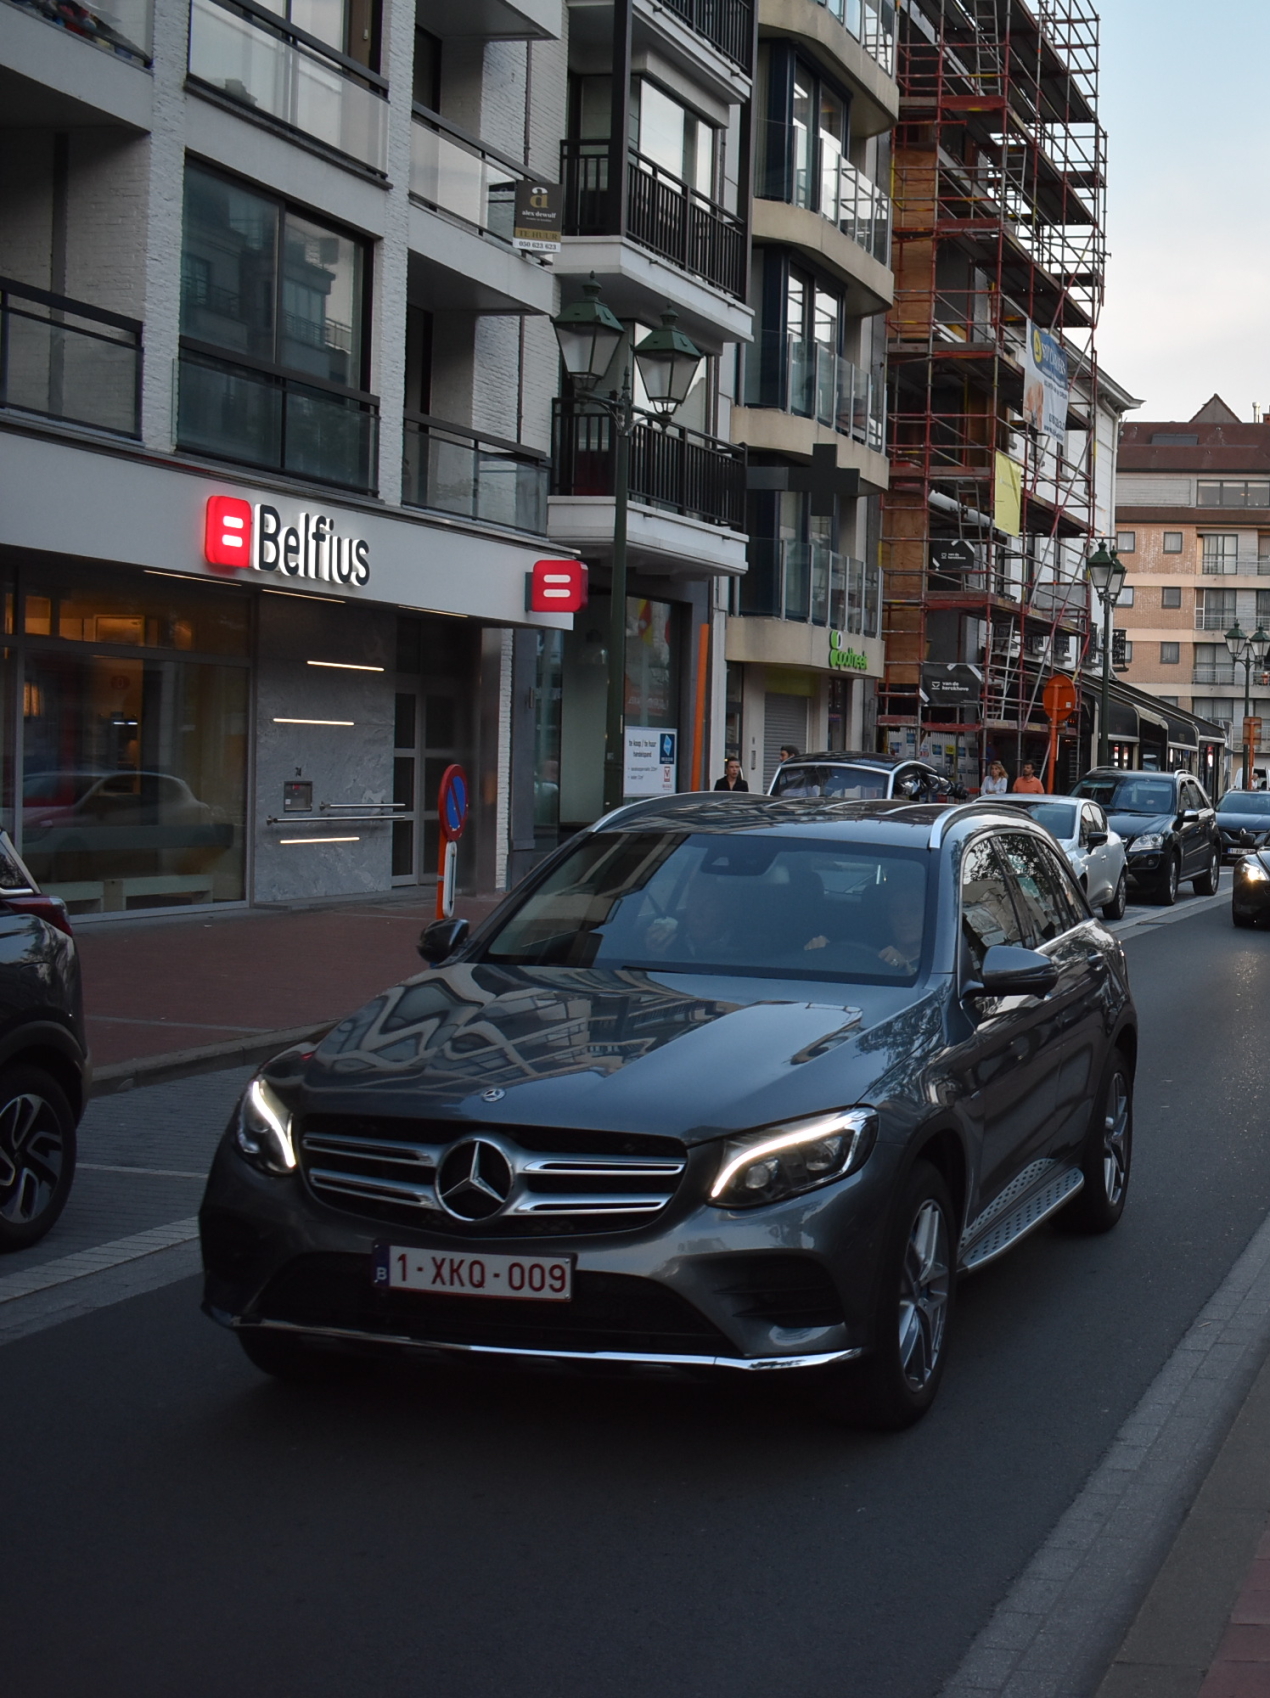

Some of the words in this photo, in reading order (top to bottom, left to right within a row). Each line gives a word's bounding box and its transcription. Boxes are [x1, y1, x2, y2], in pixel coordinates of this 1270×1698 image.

[520, 230, 530, 238] TE
[532, 231, 558, 240] HUUR
[253, 503, 370, 586] Belfius
[397, 1253, 567, 1293] 1-XKQ-009
